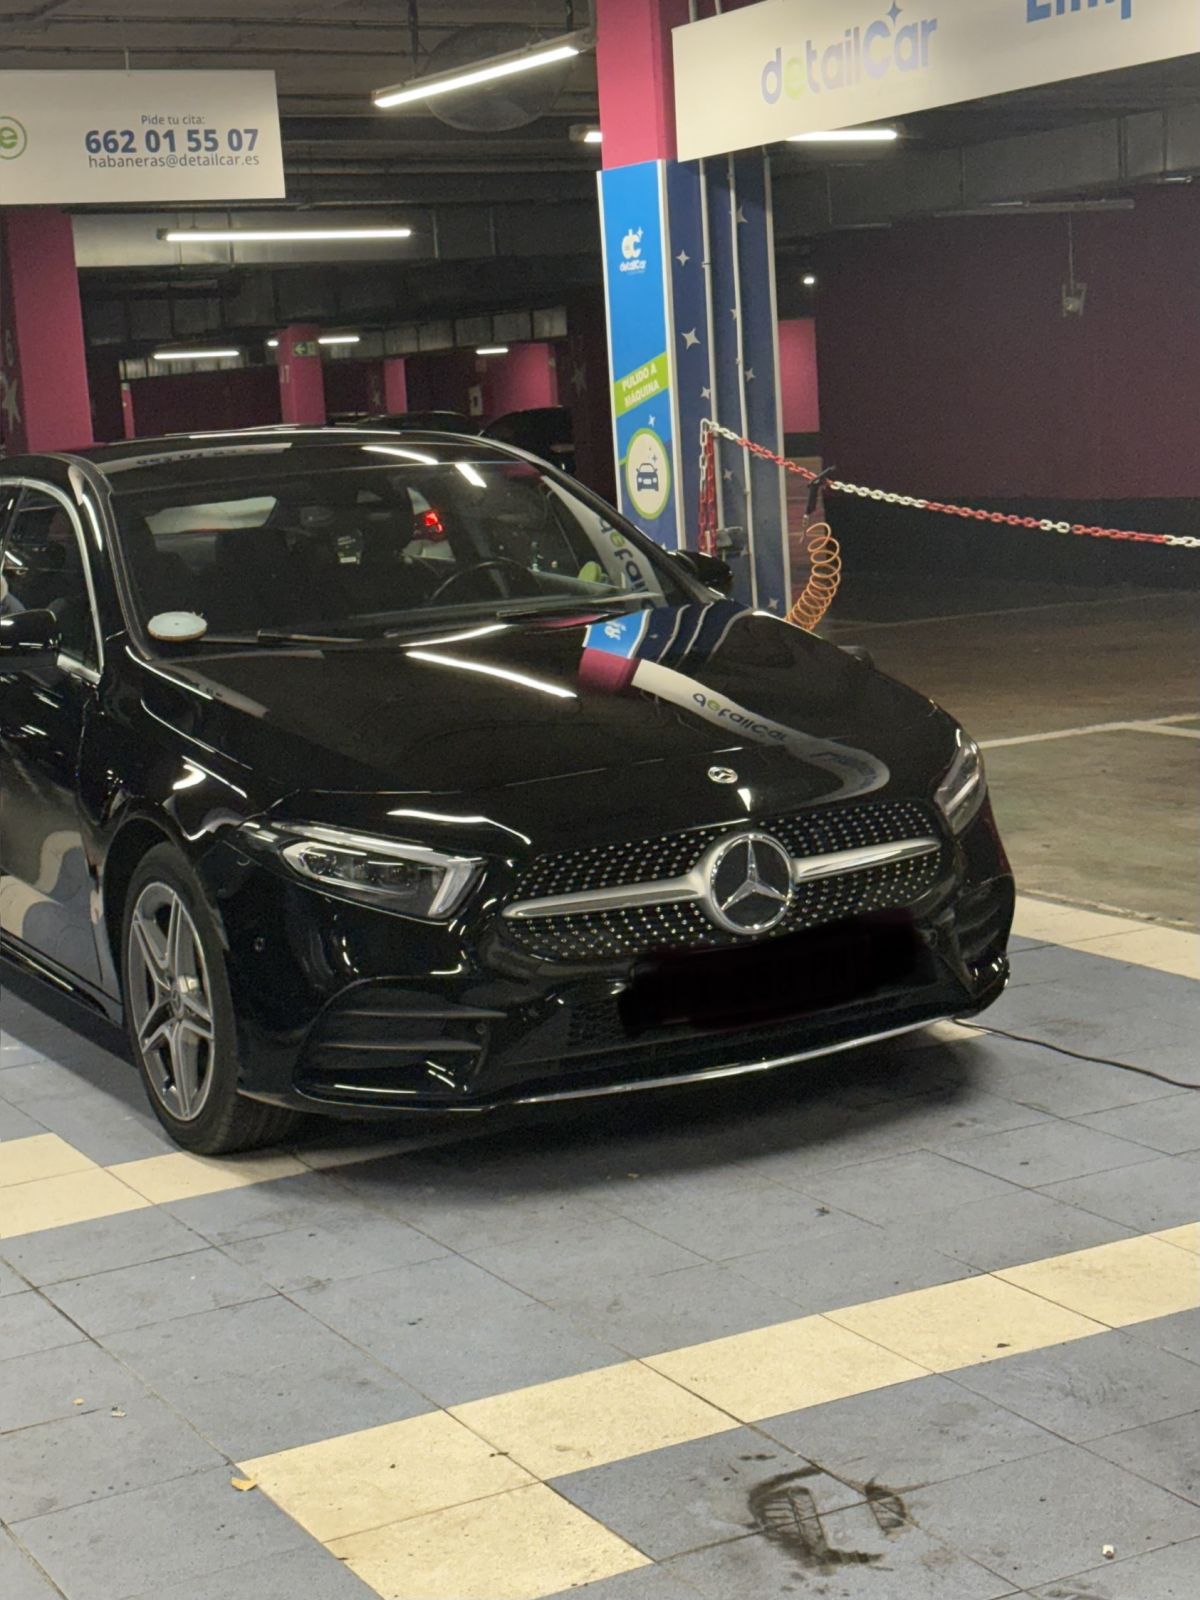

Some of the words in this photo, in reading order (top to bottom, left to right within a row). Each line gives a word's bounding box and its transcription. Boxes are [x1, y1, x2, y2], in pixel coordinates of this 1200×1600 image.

[761, 18, 938, 105] detailCar
[140, 114, 165, 125] Pide
[167, 116, 180, 125] tu
[182, 114, 206, 125] cita:
[85, 129, 137, 154] 662
[145, 129, 176, 153] 01
[187, 129, 219, 152] 55
[227, 128, 259, 151] 07
[88, 153, 260, 169] habaneras@detailcar.es
